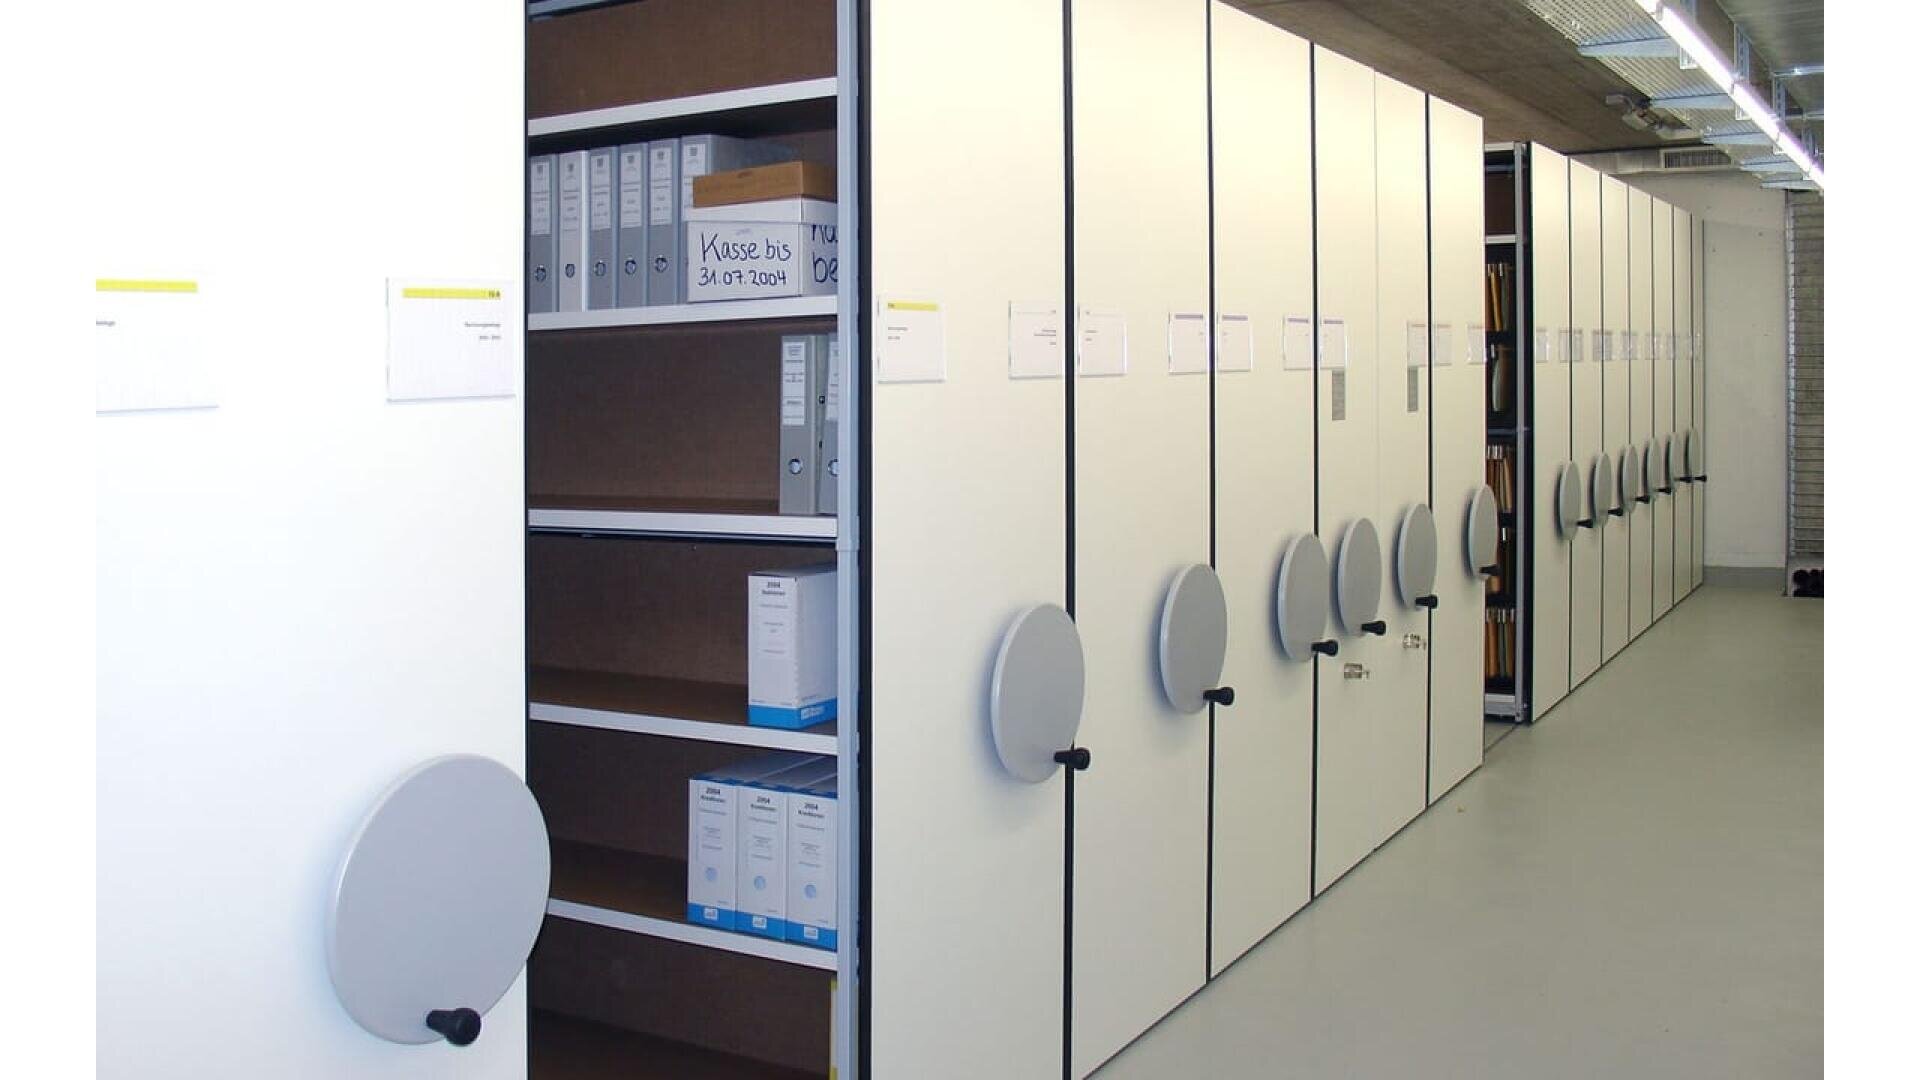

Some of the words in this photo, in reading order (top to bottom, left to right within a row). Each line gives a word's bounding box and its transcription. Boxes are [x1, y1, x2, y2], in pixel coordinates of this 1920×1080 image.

[701, 232, 760, 262] Kasse
[765, 238, 791, 261] bis
[699, 267, 787, 286] 31.07.2004
